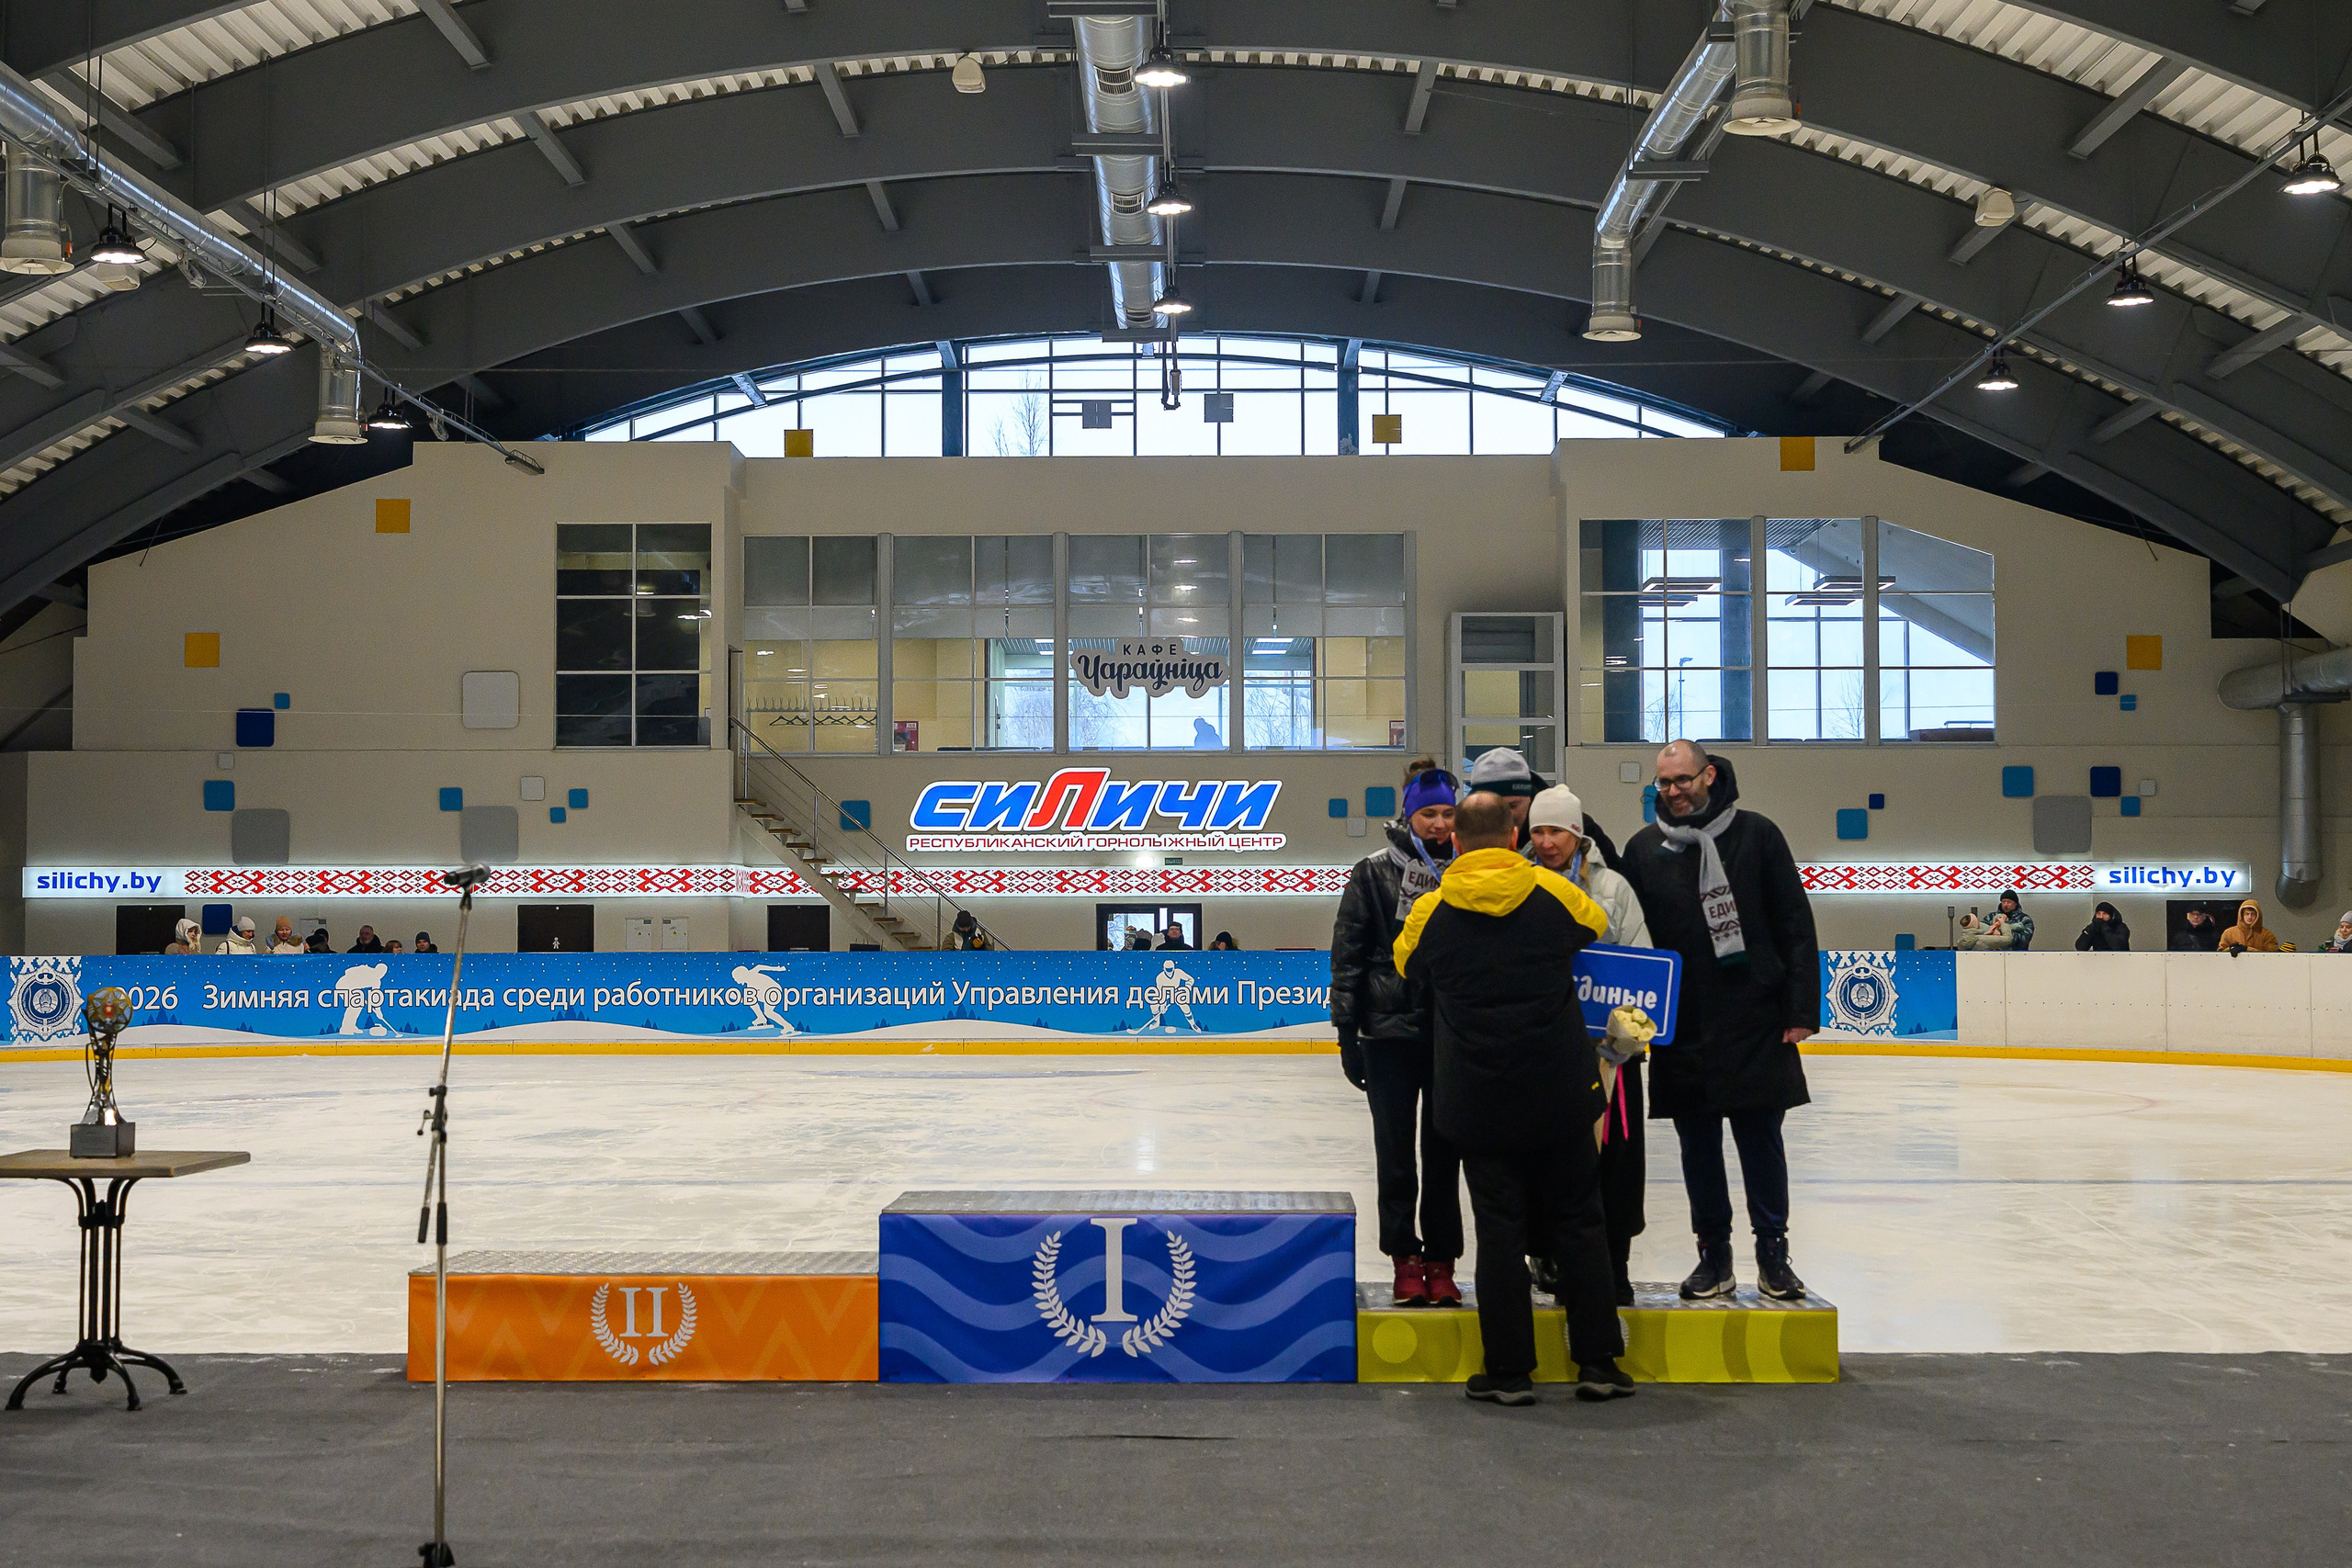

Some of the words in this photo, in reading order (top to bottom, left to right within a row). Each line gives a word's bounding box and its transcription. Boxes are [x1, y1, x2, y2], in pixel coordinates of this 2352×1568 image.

[1123, 644, 1177, 656] КАФЕ
[1078, 655, 1224, 692] Чараўніца
[910, 835, 1084, 848] РЕСПУБЛИКАНСКИЙ
[1087, 835, 1225, 848] ГОРНОЛЫЖНЫЙ
[1228, 836, 1283, 851] ЦЕНТР
[37, 872, 163, 893] silichy.by
[2109, 866, 2237, 888] silichy.by
[202, 984, 310, 1010] Зимняя
[317, 987, 495, 1013] спартакиада
[503, 987, 586, 1012] среди
[594, 980, 758, 1012] работников
[763, 981, 945, 1011] организаций
[951, 979, 1119, 1011] Управления
[1125, 986, 1229, 1010] делами
[1572, 975, 1657, 1010] диные
[1090, 1217, 1138, 1323] I
[618, 1287, 669, 1337] II
